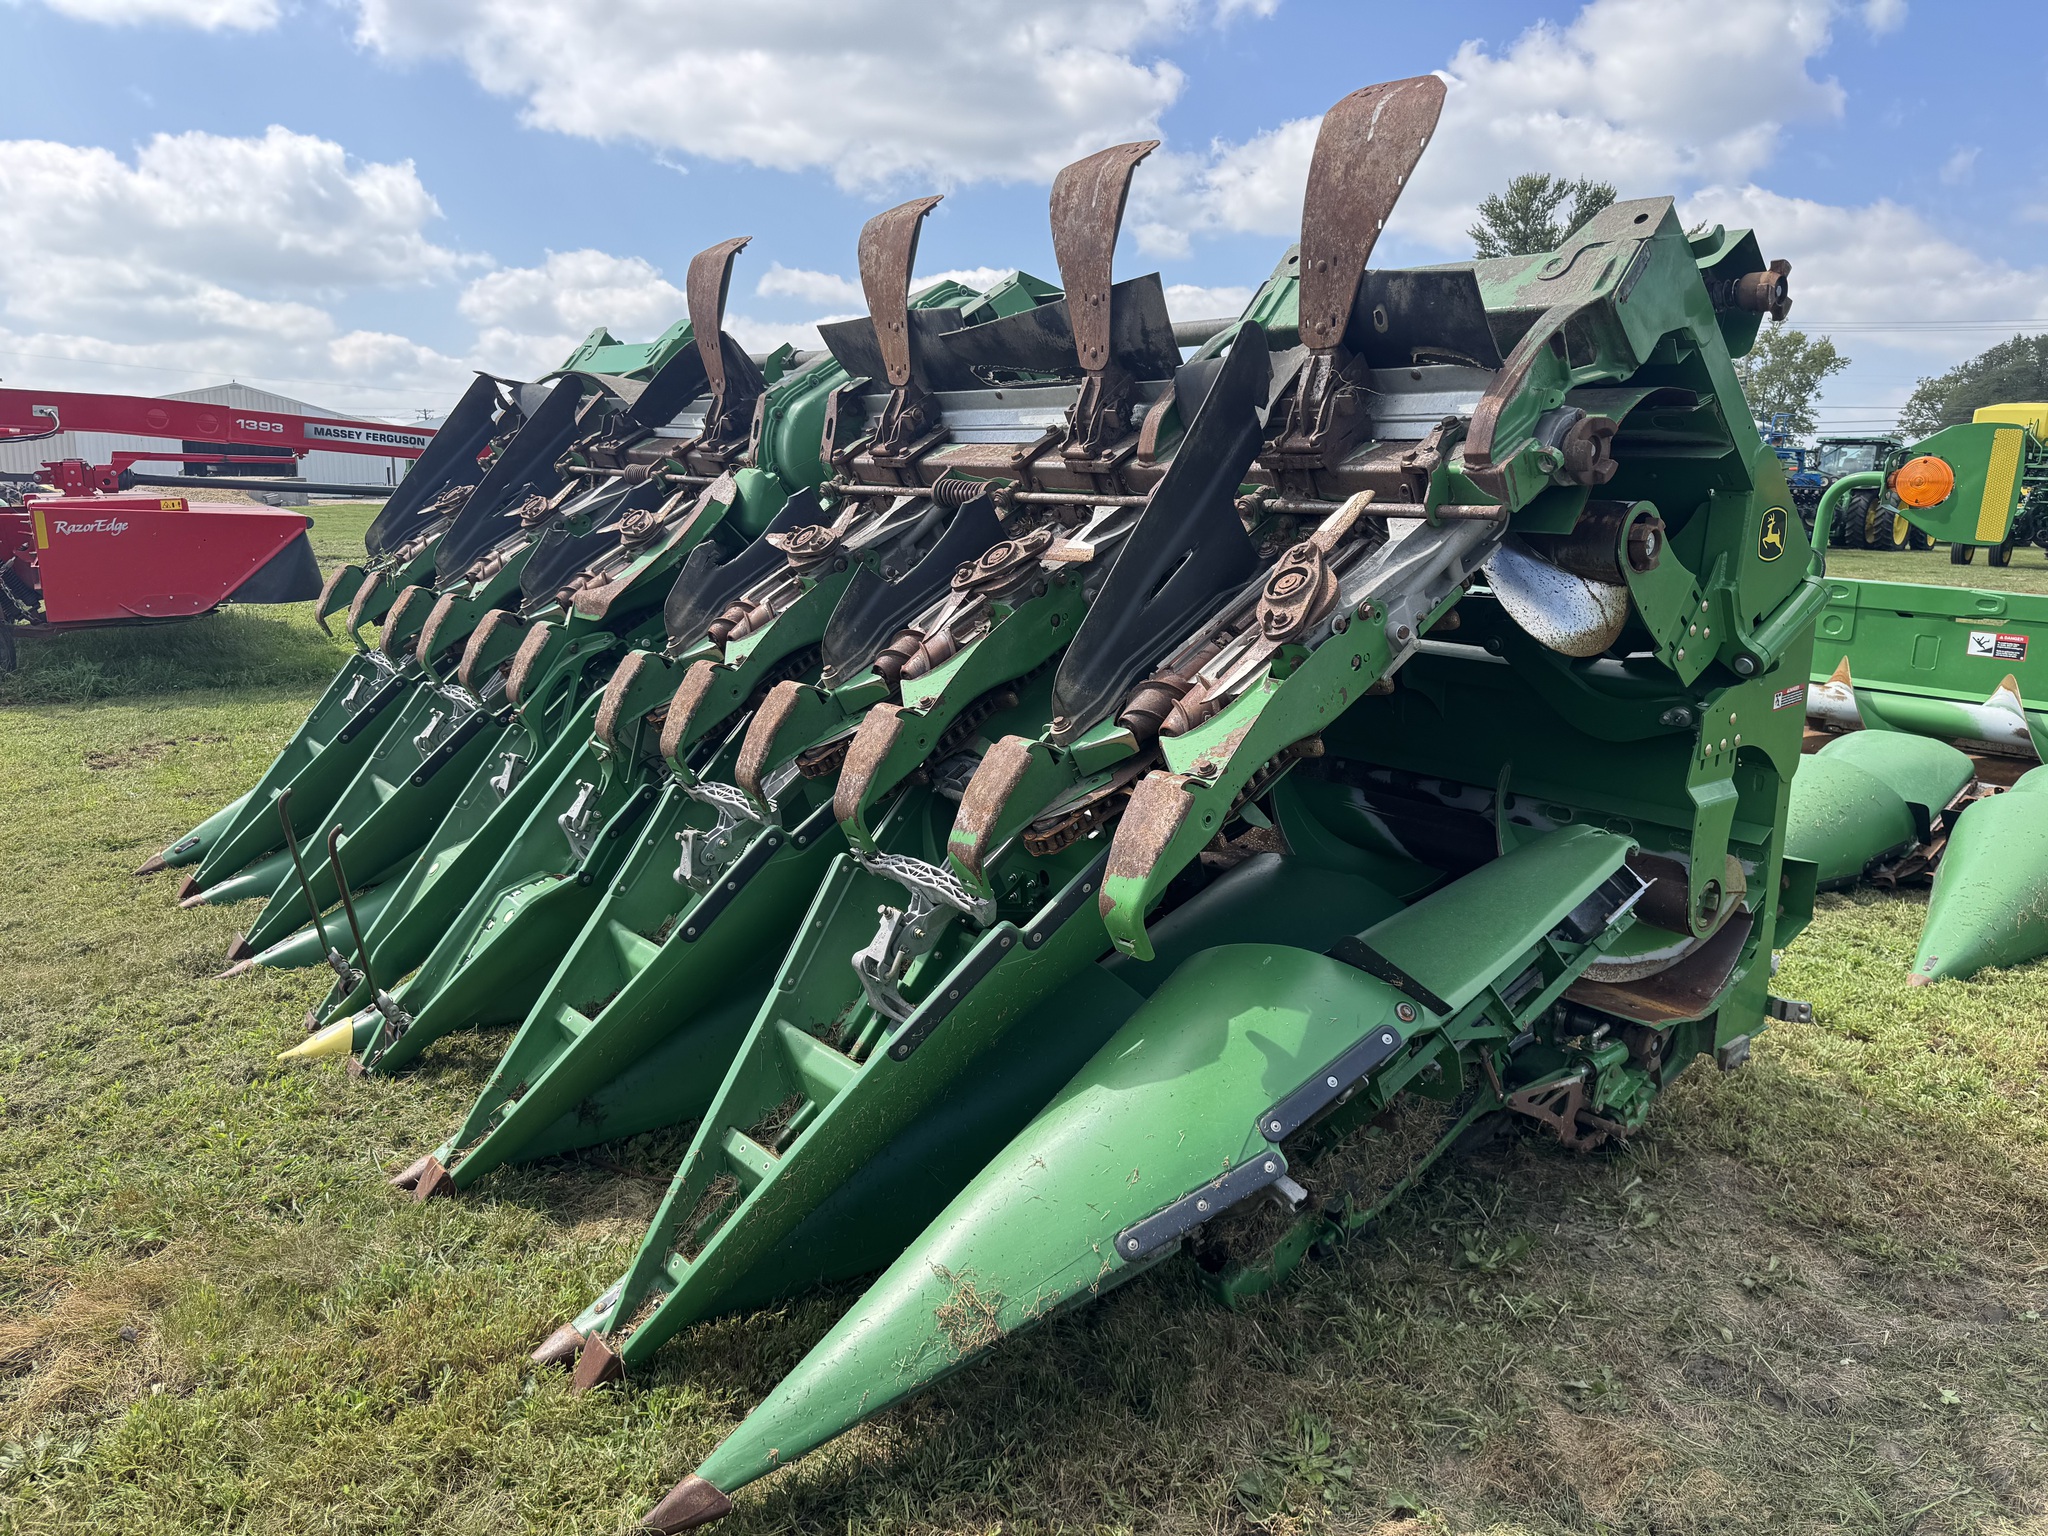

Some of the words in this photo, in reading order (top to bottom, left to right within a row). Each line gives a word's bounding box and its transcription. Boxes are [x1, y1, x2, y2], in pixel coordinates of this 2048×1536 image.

[235, 419, 284, 433] 1393
[314, 427, 362, 440] MASSEY
[365, 432, 425, 446] FERGUSON
[53, 517, 129, 536] RazorEdge
